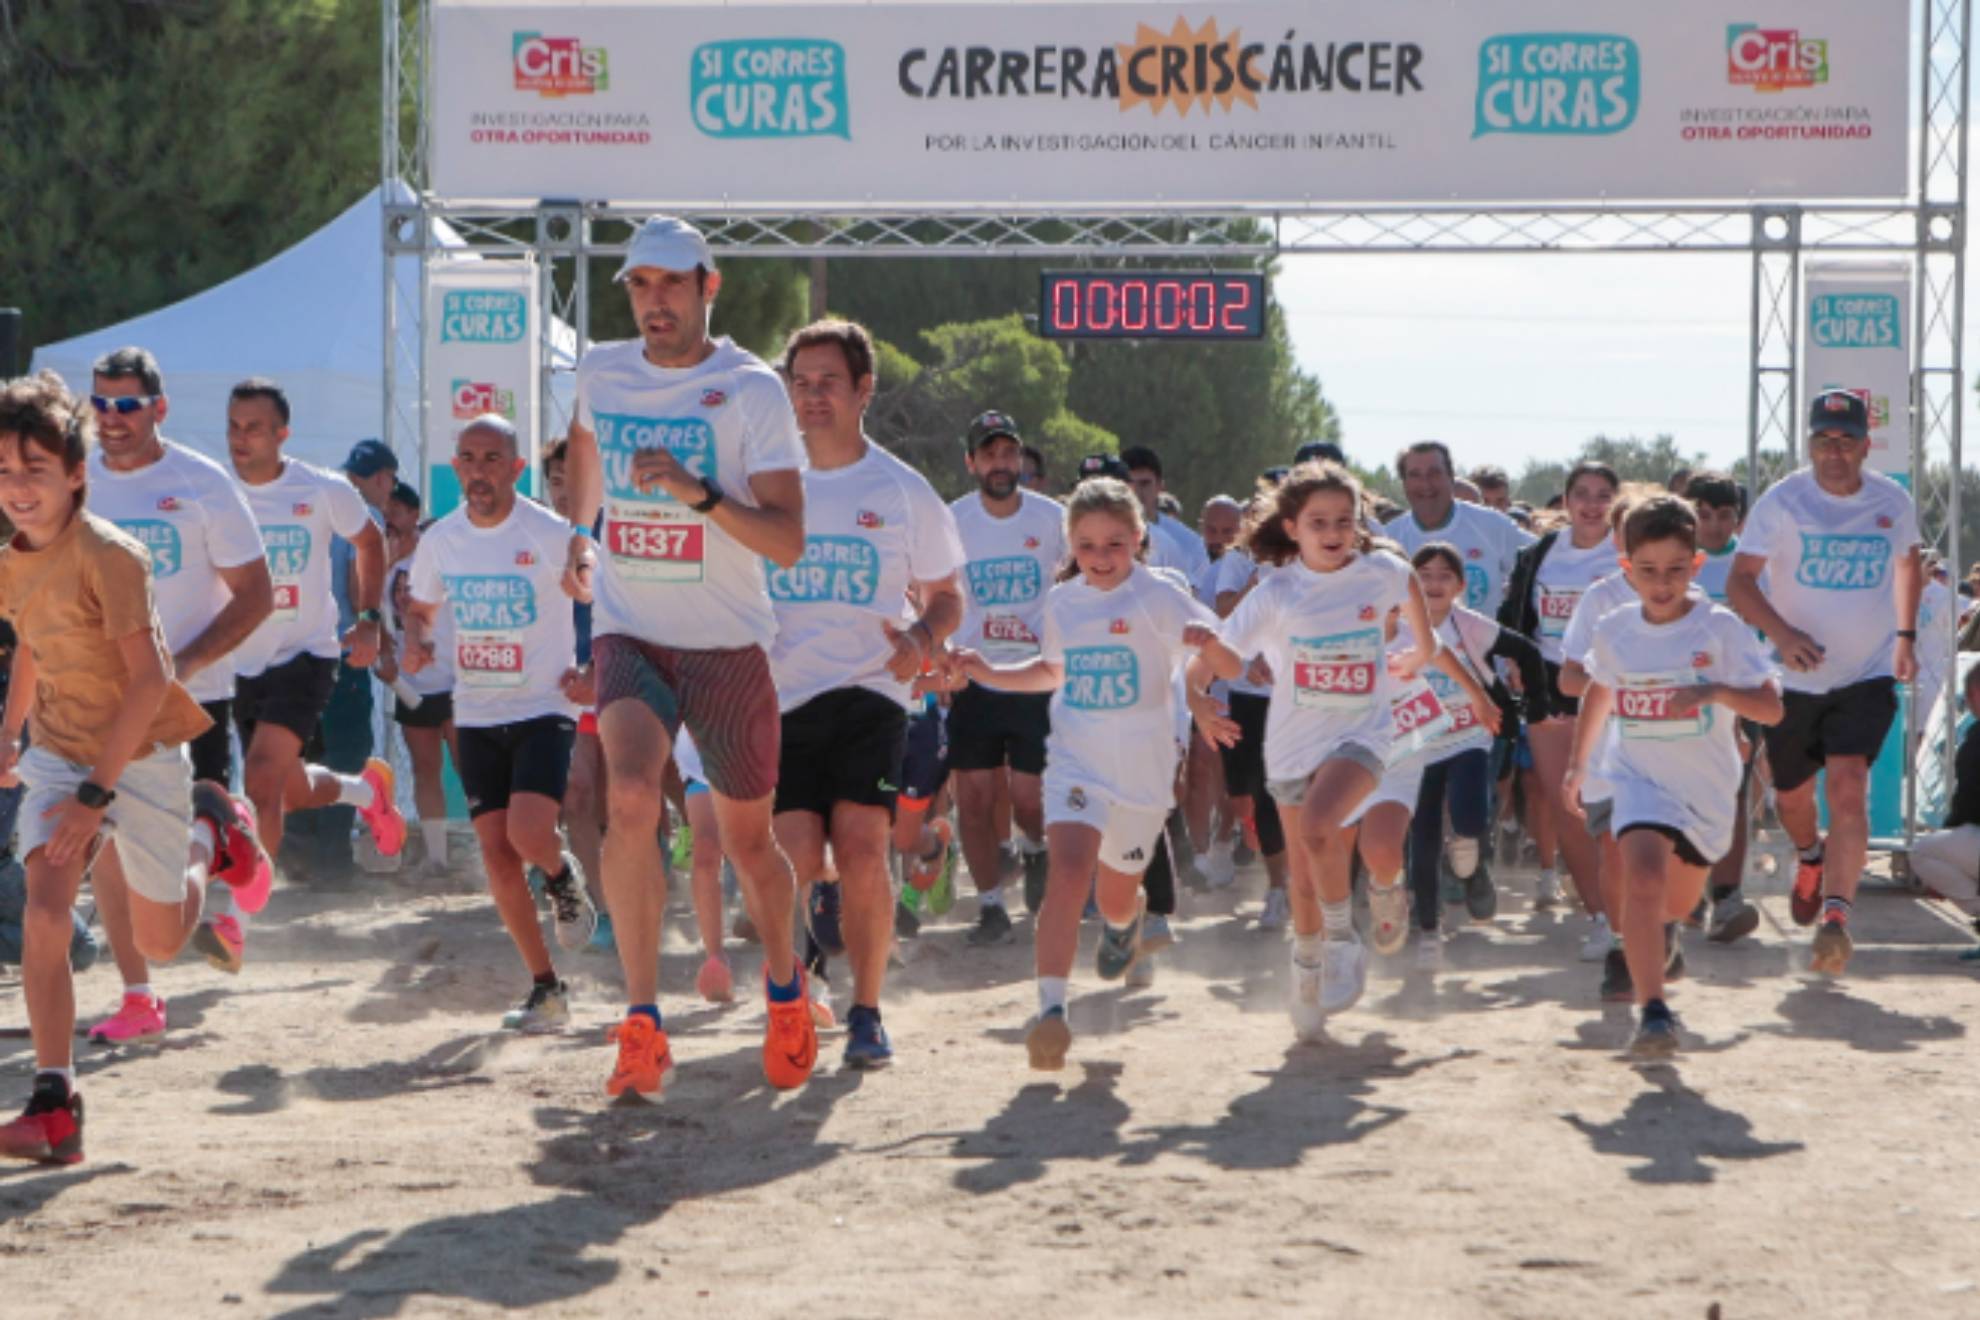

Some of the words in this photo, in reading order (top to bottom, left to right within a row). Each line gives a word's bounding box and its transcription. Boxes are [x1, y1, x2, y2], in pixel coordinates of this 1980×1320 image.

[518, 37, 603, 78] Cris
[700, 48, 724, 79] SI
[733, 46, 834, 77] CORRES
[1487, 43, 1511, 75] SI
[1522, 41, 1627, 74] CORRES
[1731, 31, 1824, 71] Cris
[696, 82, 837, 132] CURAS
[1482, 76, 1628, 129] CURAS
[1824, 106, 1872, 122] PARA
[604, 112, 650, 127] PARA
[1681, 125, 1733, 141] OTRA
[1737, 124, 1872, 140] OPORTUNIDAD
[471, 130, 518, 145] OTRA
[522, 130, 651, 145] OPORTUNIDAD
[925, 134, 967, 151] POR
[973, 134, 997, 151] LA
[1160, 133, 1198, 150] DEL
[1303, 132, 1399, 149] INFANTIL
[1052, 279, 1250, 331] 00:00:02
[446, 313, 520, 340] CURAS
[1814, 317, 1893, 344] CURAS
[621, 423, 707, 450] CORRES
[618, 524, 689, 558] 1337
[806, 542, 872, 566] ORRES
[771, 565, 871, 600] CURAS
[1801, 558, 1886, 586] CURAS
[463, 579, 529, 599] CORRES
[1306, 665, 1368, 689] 1349
